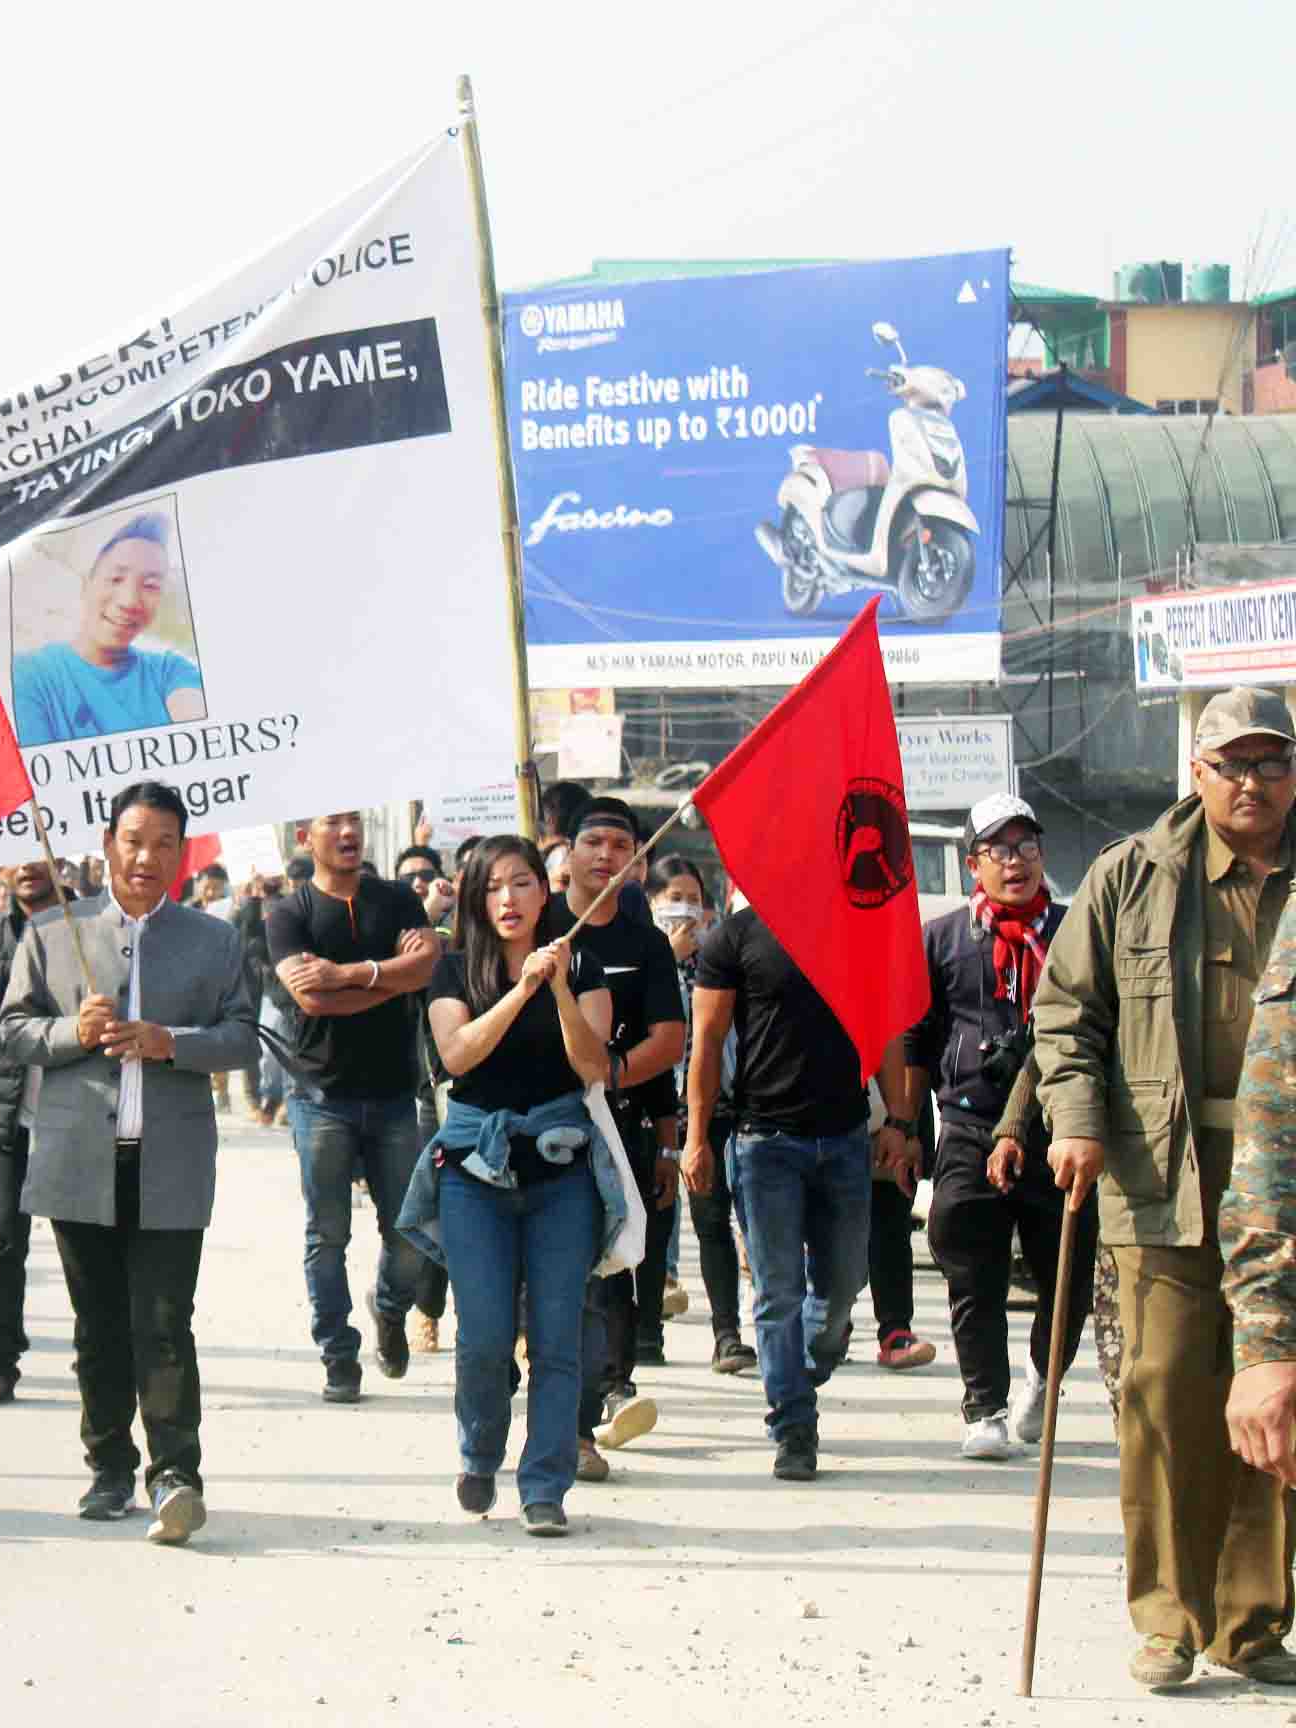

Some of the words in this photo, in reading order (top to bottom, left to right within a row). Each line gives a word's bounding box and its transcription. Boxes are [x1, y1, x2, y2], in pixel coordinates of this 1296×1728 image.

[543, 299, 625, 333] YAMAHA
[42, 290, 283, 423] INCOMPETEN
[165, 367, 272, 432] TOKO
[281, 340, 418, 395] YAME,
[520, 377, 579, 412] Ride
[585, 369, 681, 408] Festive
[686, 363, 749, 401] with
[521, 413, 630, 451] Benefits
[636, 417, 672, 450] up
[678, 411, 708, 442] to
[64, 713, 300, 783] MURDERS?
[937, 727, 993, 745] Works
[82, 772, 252, 826] Itgar
